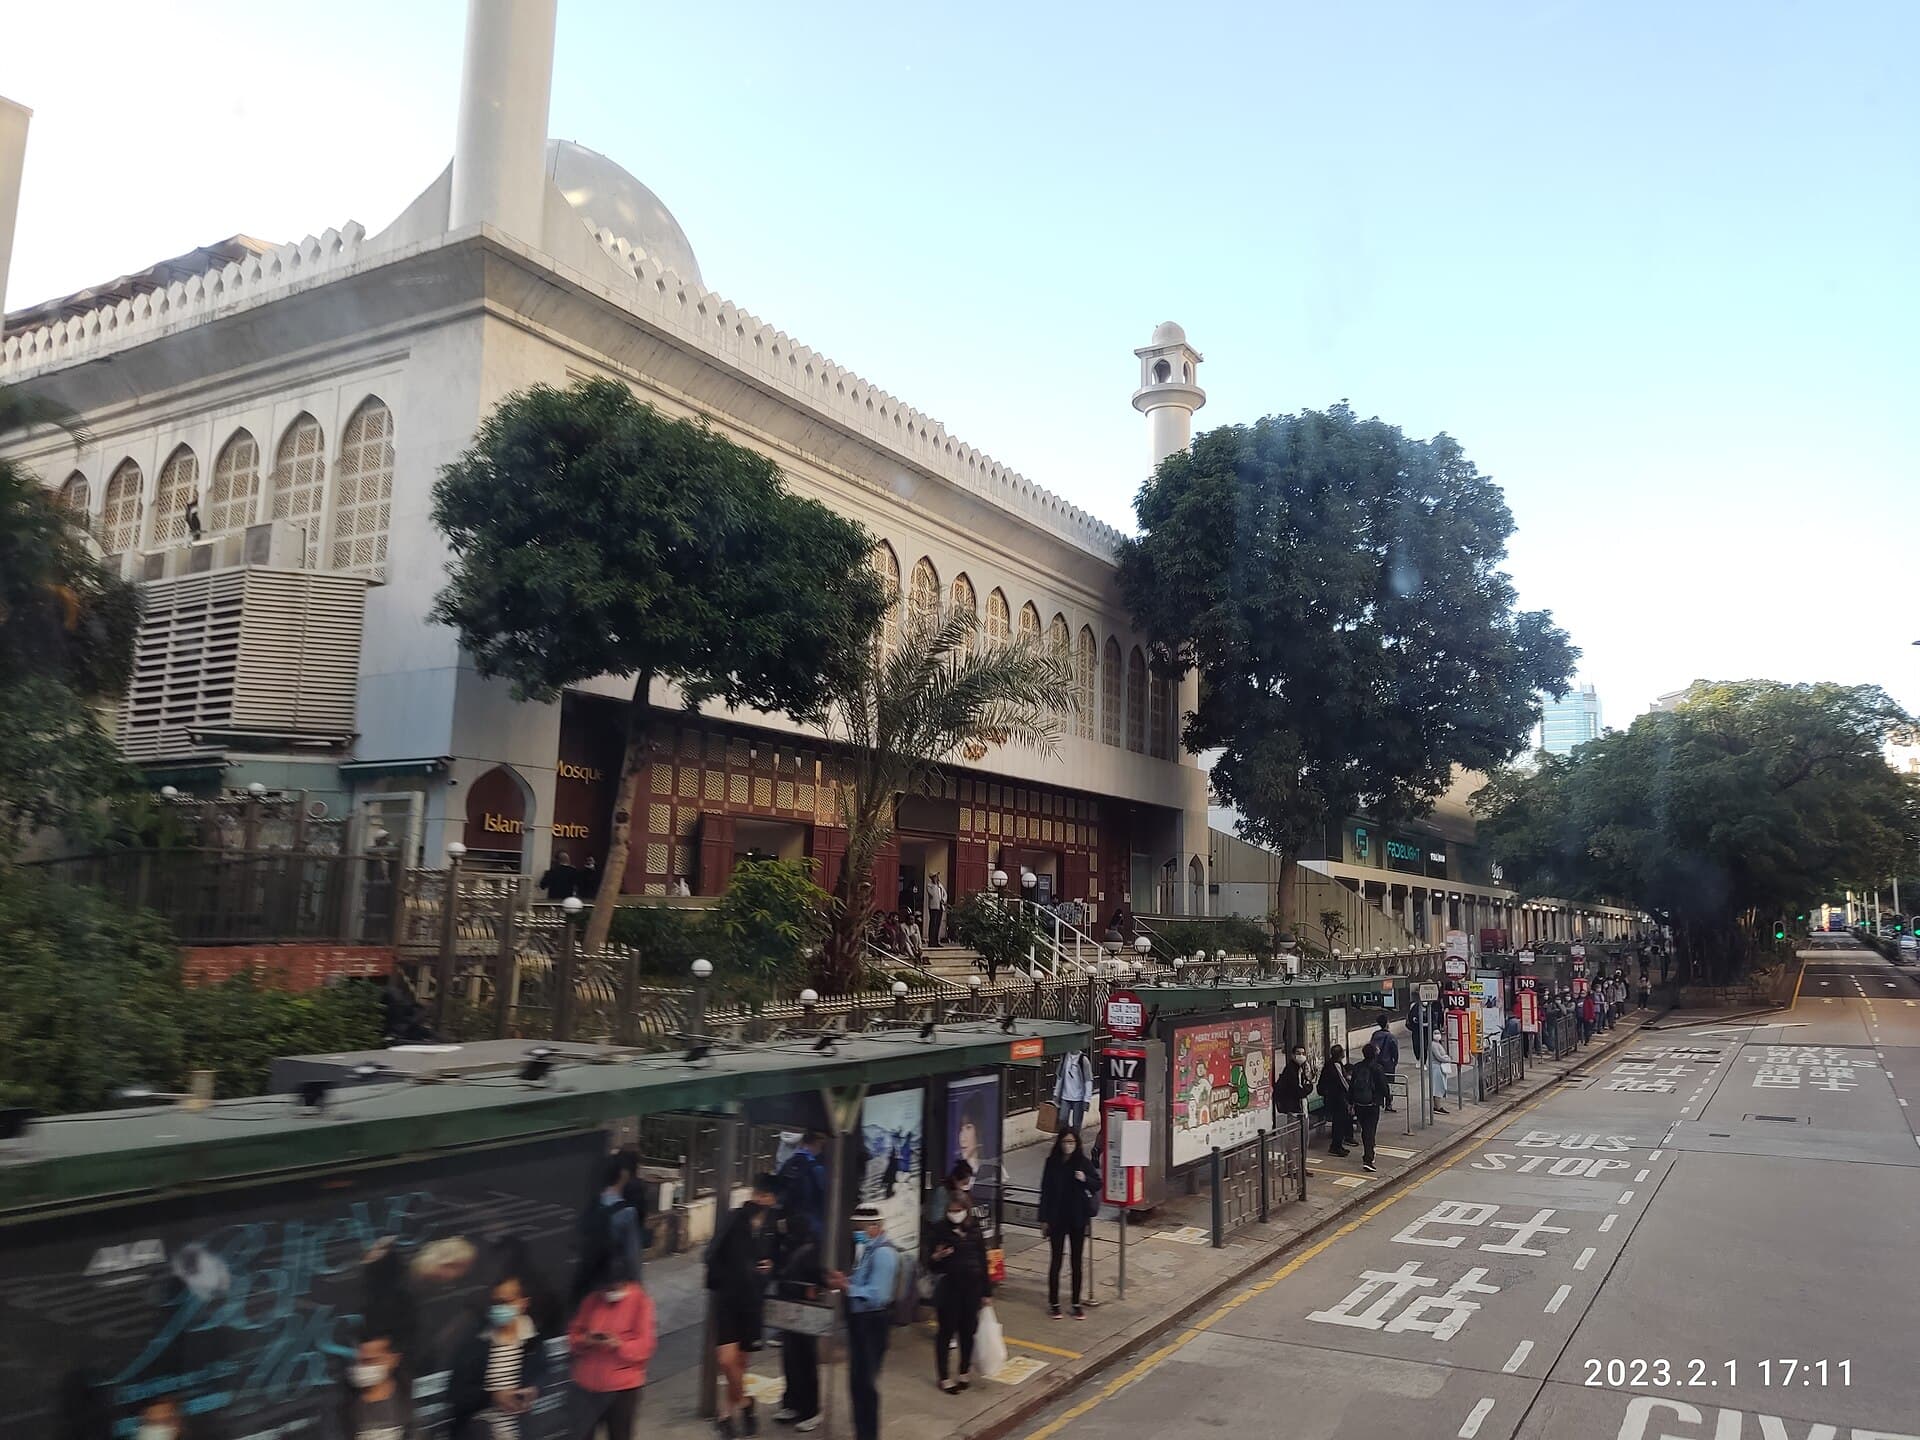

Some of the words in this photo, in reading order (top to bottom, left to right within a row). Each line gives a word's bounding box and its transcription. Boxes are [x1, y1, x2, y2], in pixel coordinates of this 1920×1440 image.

[1521, 979, 1535, 988] N9
[1449, 995, 1465, 1007] N8
[1744, 1055, 1790, 1063] TO
[1797, 1058, 1878, 1068] BUS
[1767, 1051, 1845, 1059] WAY
[1110, 1059, 1138, 1078] N7
[1611, 1063, 1696, 1077] 巴士
[1602, 1077, 1677, 1093] 站
[1752, 1075, 1859, 1092] 巴士
[1515, 1130, 1636, 1152] BUS
[1471, 1153, 1631, 1178] STOP
[1390, 1200, 1571, 1257] 巴士
[1305, 1261, 1501, 1342] 站
[1616, 1396, 1920, 1440] GI
